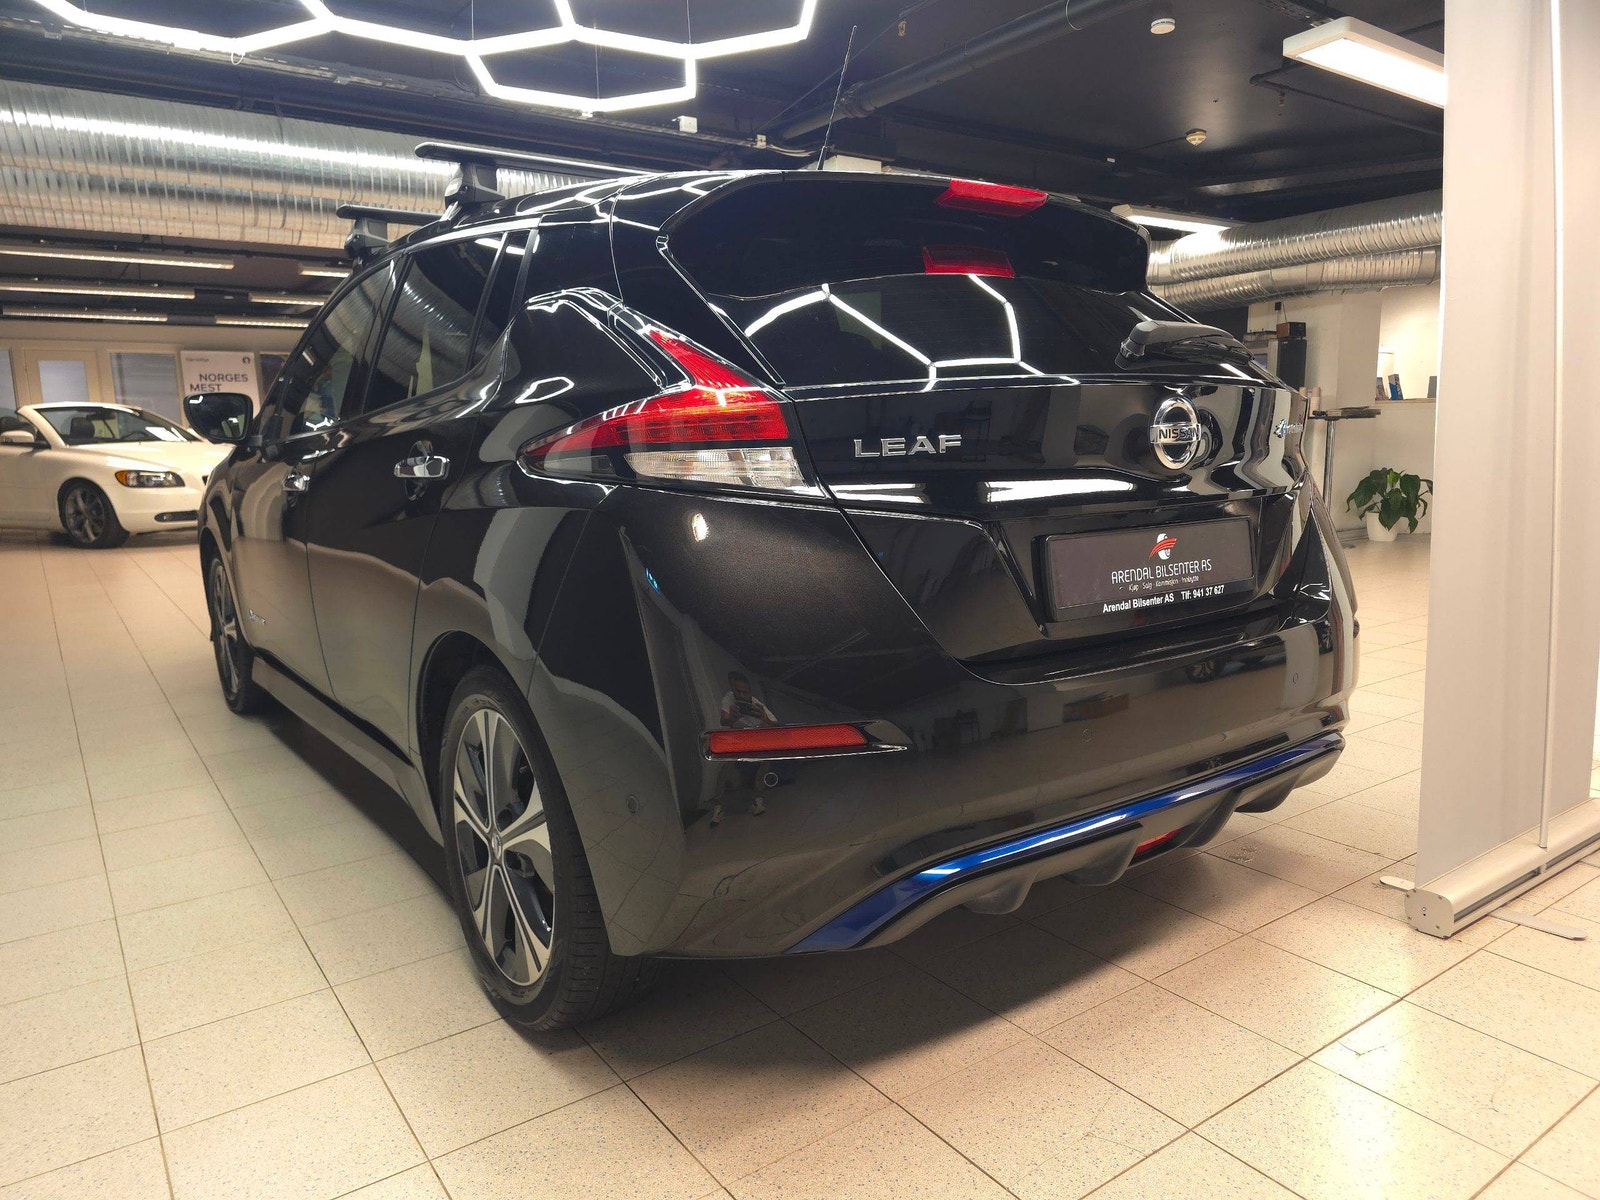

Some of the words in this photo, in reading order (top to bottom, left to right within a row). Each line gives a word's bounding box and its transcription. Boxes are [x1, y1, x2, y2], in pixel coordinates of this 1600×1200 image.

[199, 373, 248, 382] NORGES
[190, 383, 222, 392] MEST
[1158, 425, 1200, 440] NISSAN
[853, 434, 963, 458] LEAF
[1111, 567, 1154, 584] ARENDAL
[1155, 561, 1200, 578] BILSENTER
[1201, 559, 1212, 571] AS
[1103, 600, 1131, 613] Arendal
[1132, 596, 1163, 609] Bilsenter
[1164, 593, 1175, 604] AS
[1193, 588, 1204, 599] 941
[1206, 586, 1213, 597] 37
[1214, 584, 1225, 595] 627
